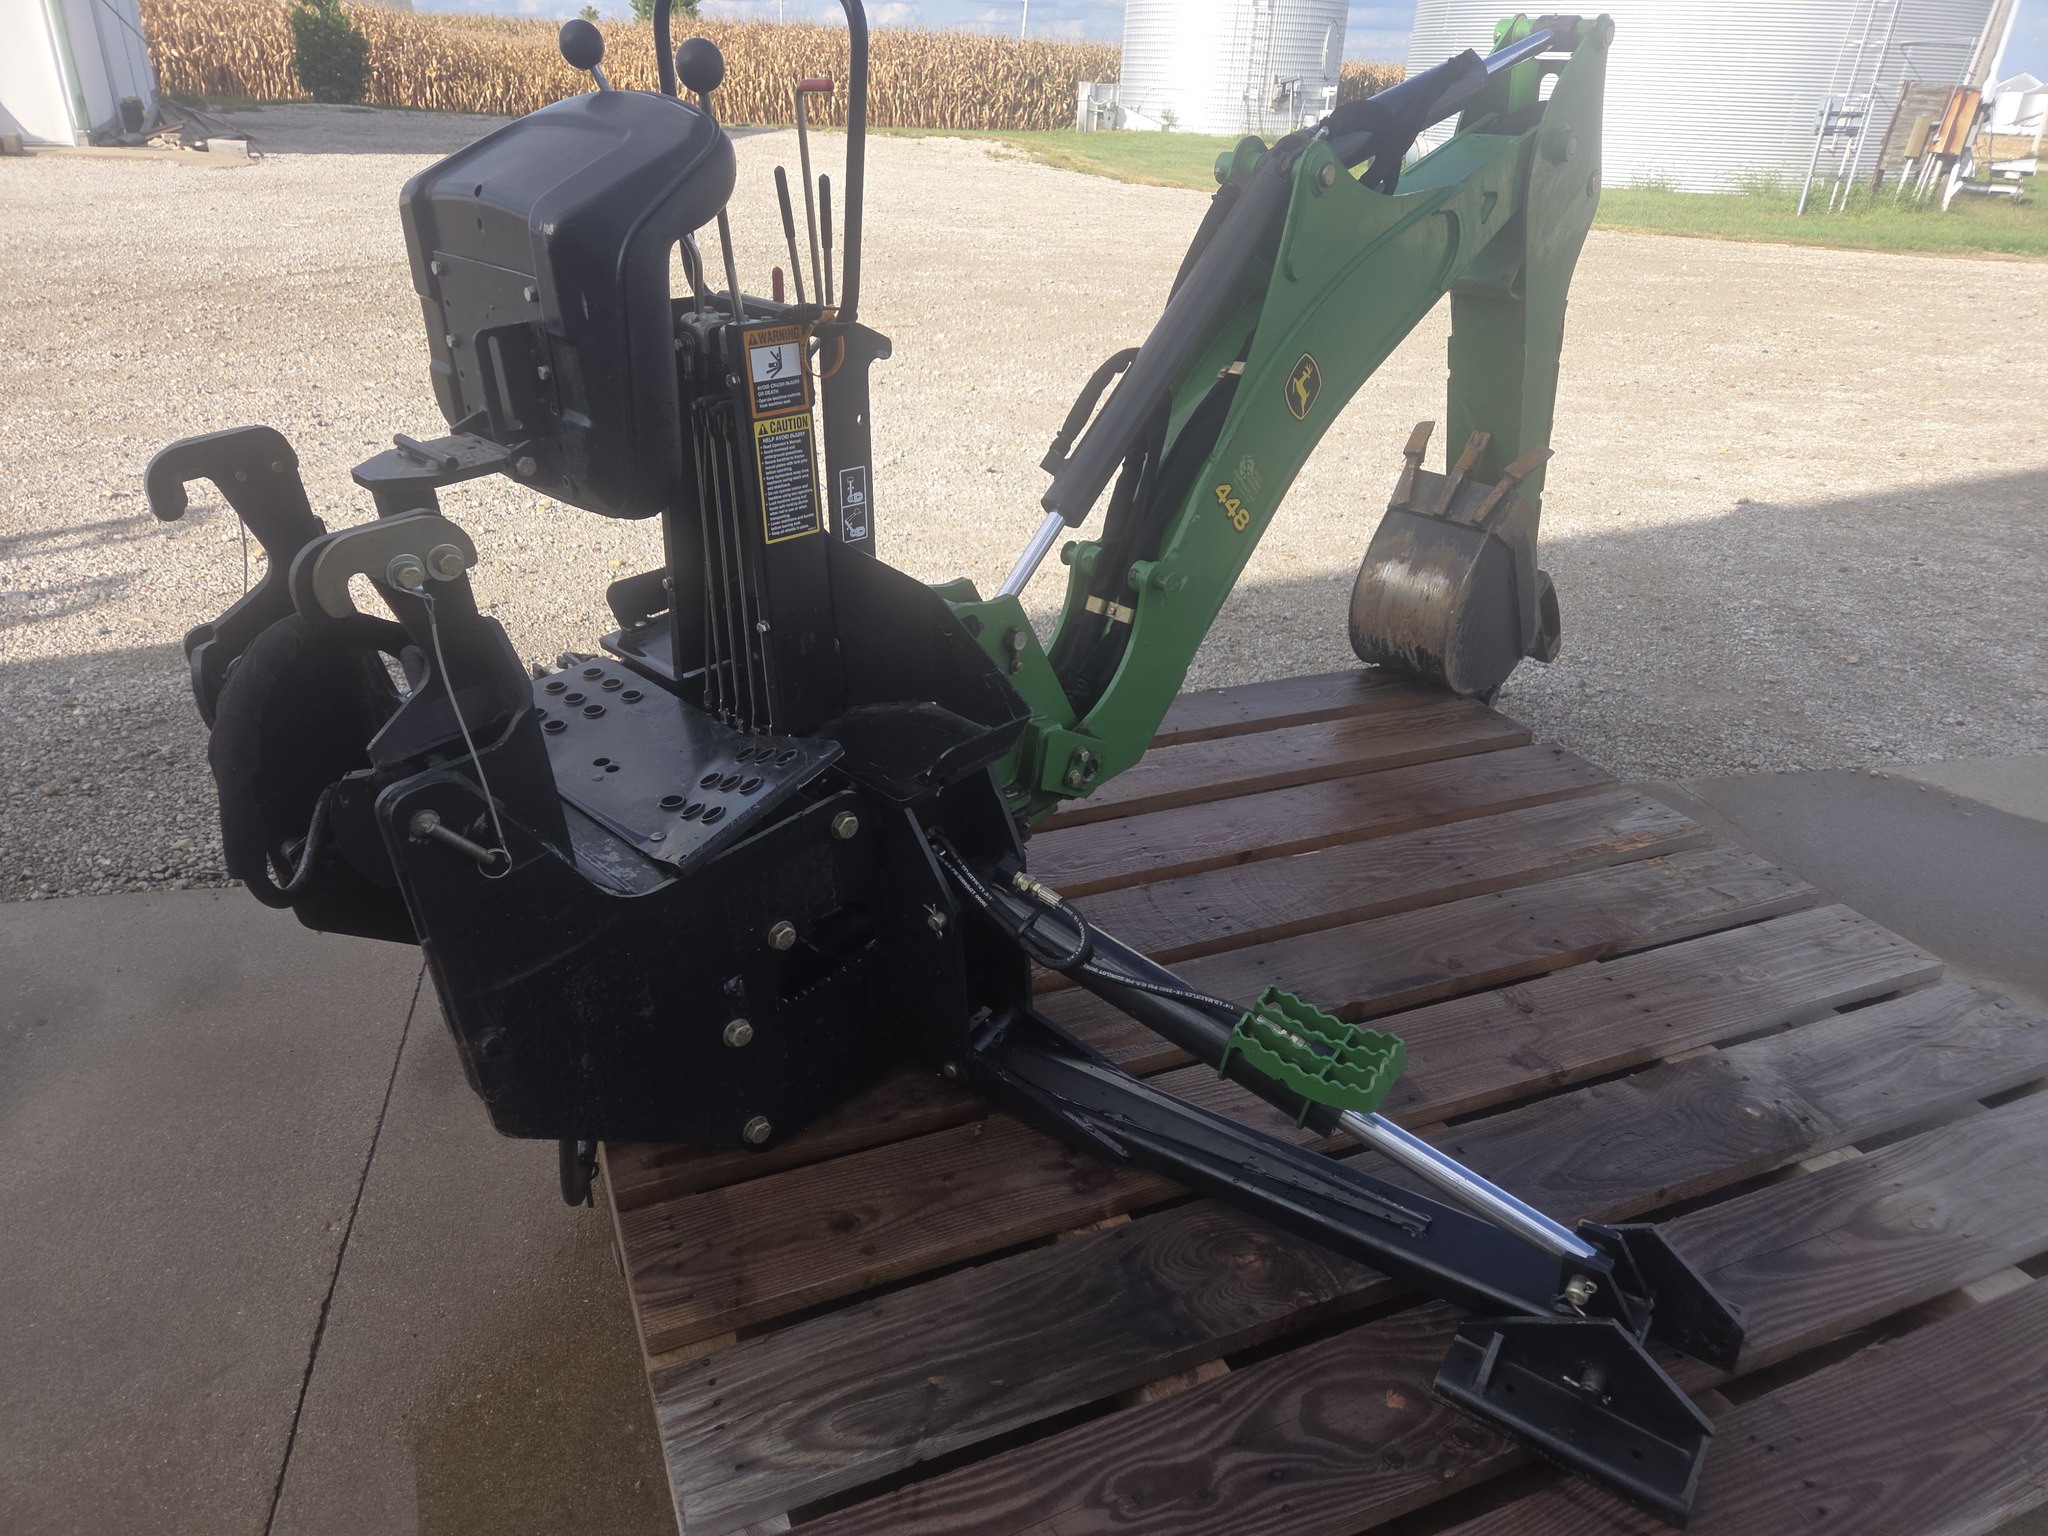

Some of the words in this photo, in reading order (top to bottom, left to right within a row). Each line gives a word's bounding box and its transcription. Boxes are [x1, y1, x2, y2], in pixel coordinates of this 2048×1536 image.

[758, 327, 800, 344] WARNING
[770, 416, 808, 433] CAUTION
[1215, 484, 1250, 531] 448
